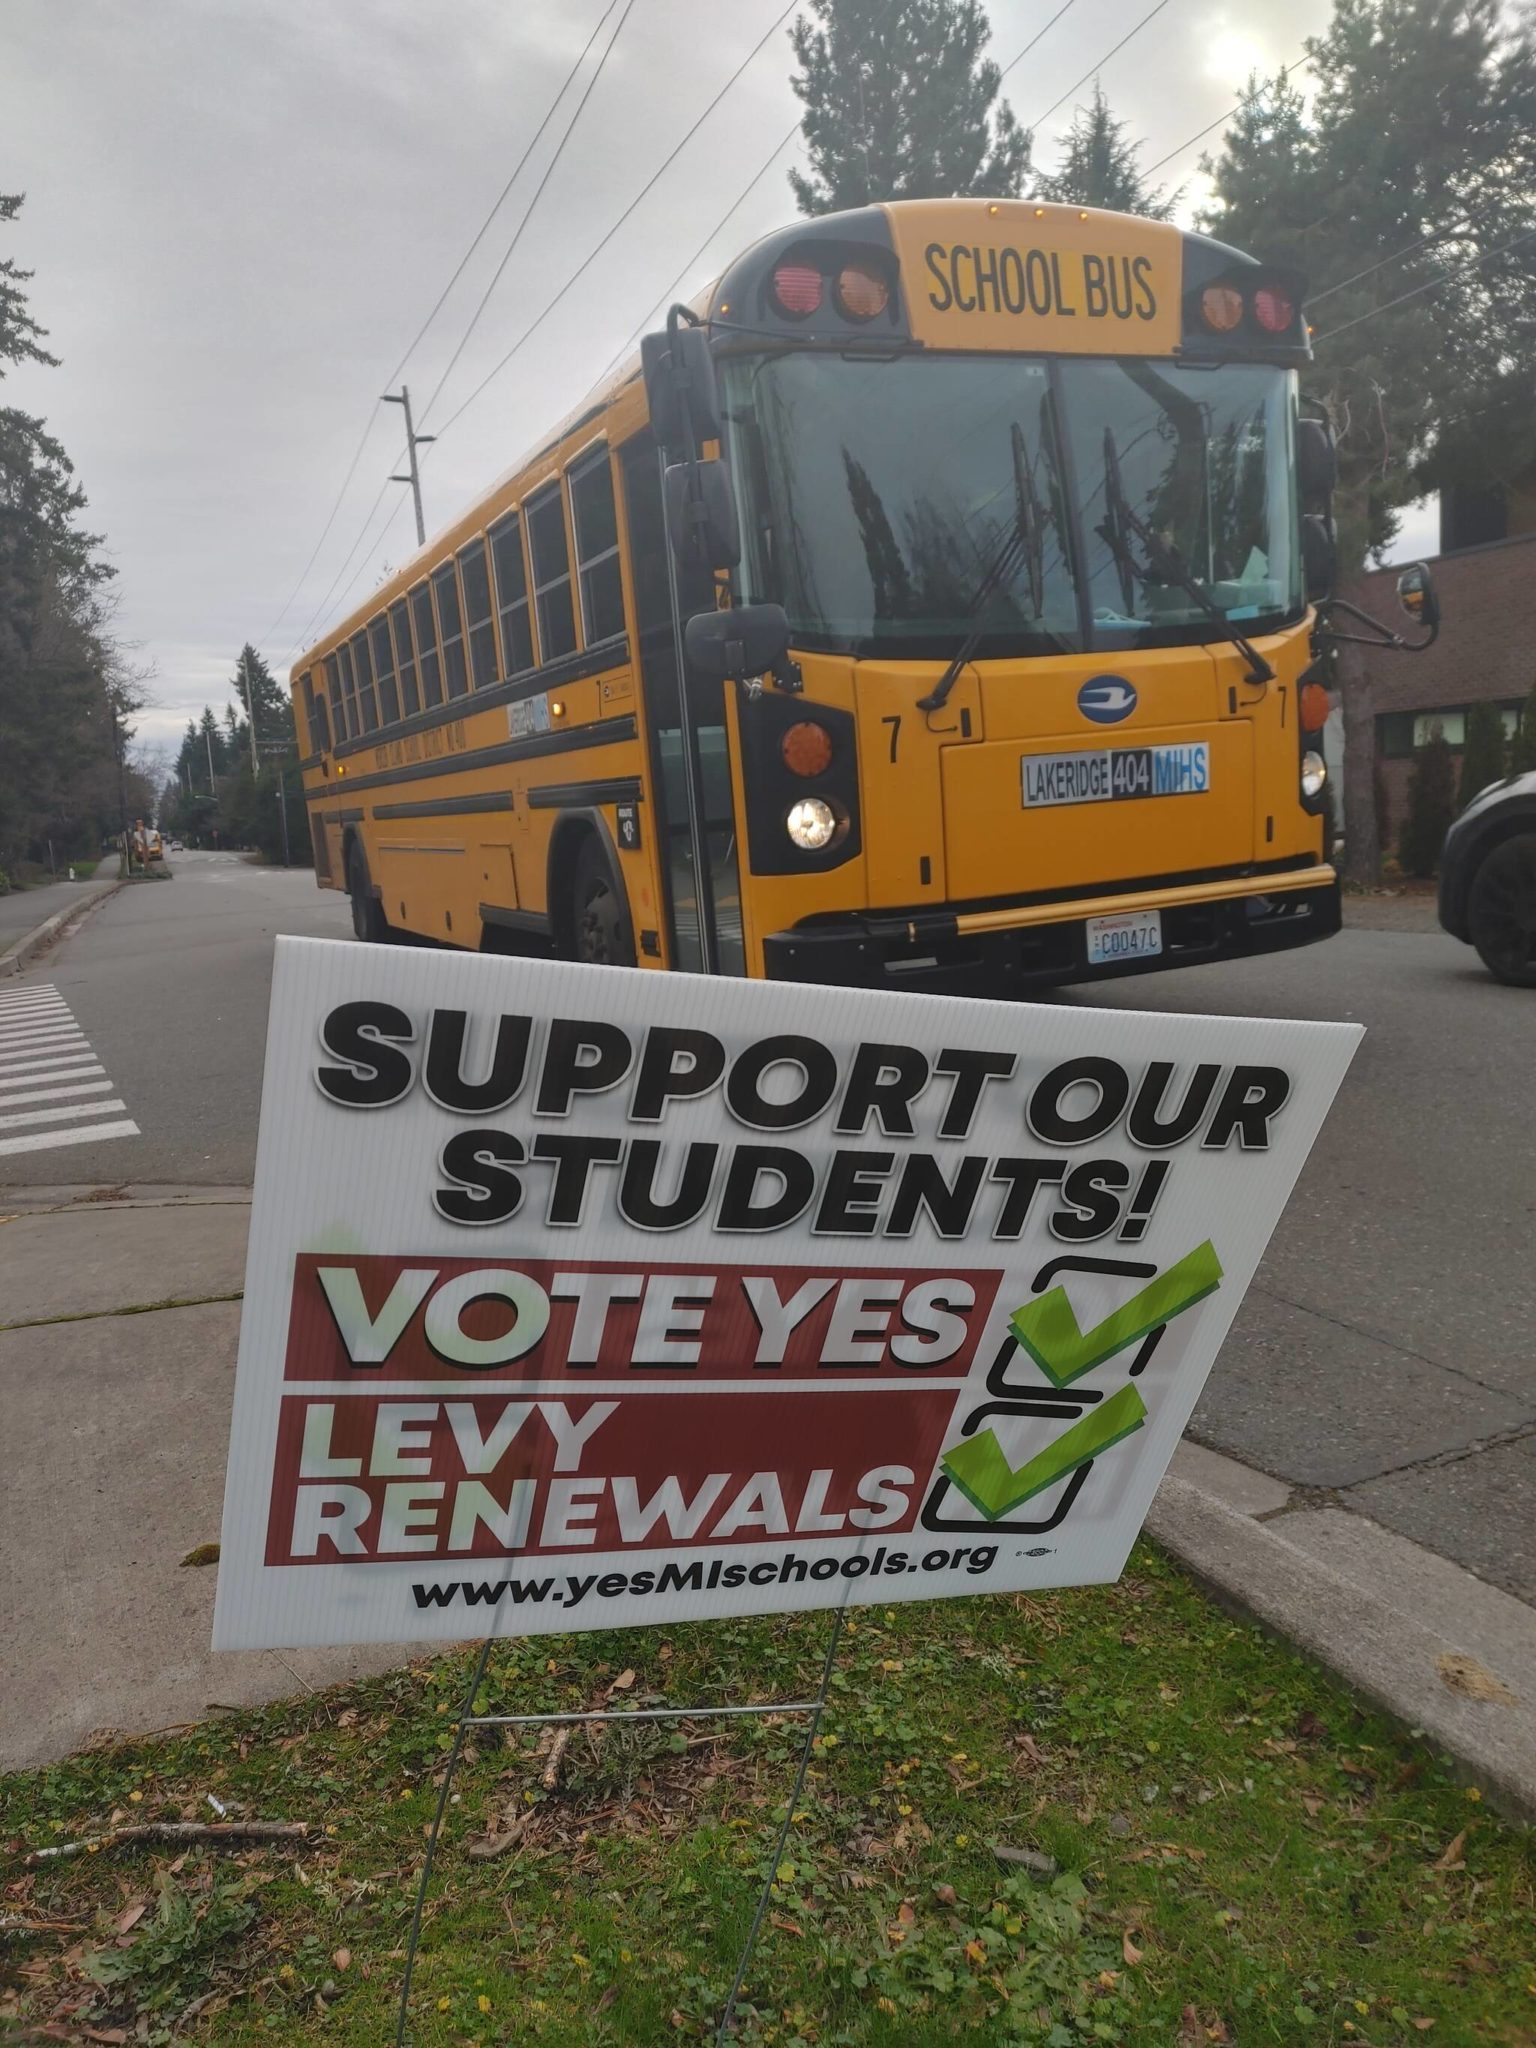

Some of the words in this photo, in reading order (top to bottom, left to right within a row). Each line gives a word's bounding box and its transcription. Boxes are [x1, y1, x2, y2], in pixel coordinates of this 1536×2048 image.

[925, 243, 1076, 316] SCHOOL
[1083, 254, 1157, 320] BUS
[881, 715, 901, 763] 7
[1278, 686, 1286, 728] 7
[1026, 758, 1109, 801] LAKERIDGE
[1113, 753, 1149, 793] 404
[1155, 747, 1207, 793] MIHS
[316, 1001, 1018, 1137] SUPPORT
[1027, 1056, 1291, 1148] OUR
[434, 1129, 1172, 1242] STUDENTS!
[316, 1267, 717, 1370] VOTE
[740, 1278, 976, 1368] YES
[299, 1401, 621, 1478] LEVY
[290, 1465, 915, 1556] RENEWALS
[411, 1546, 998, 1608] www.yesMIschools.org
